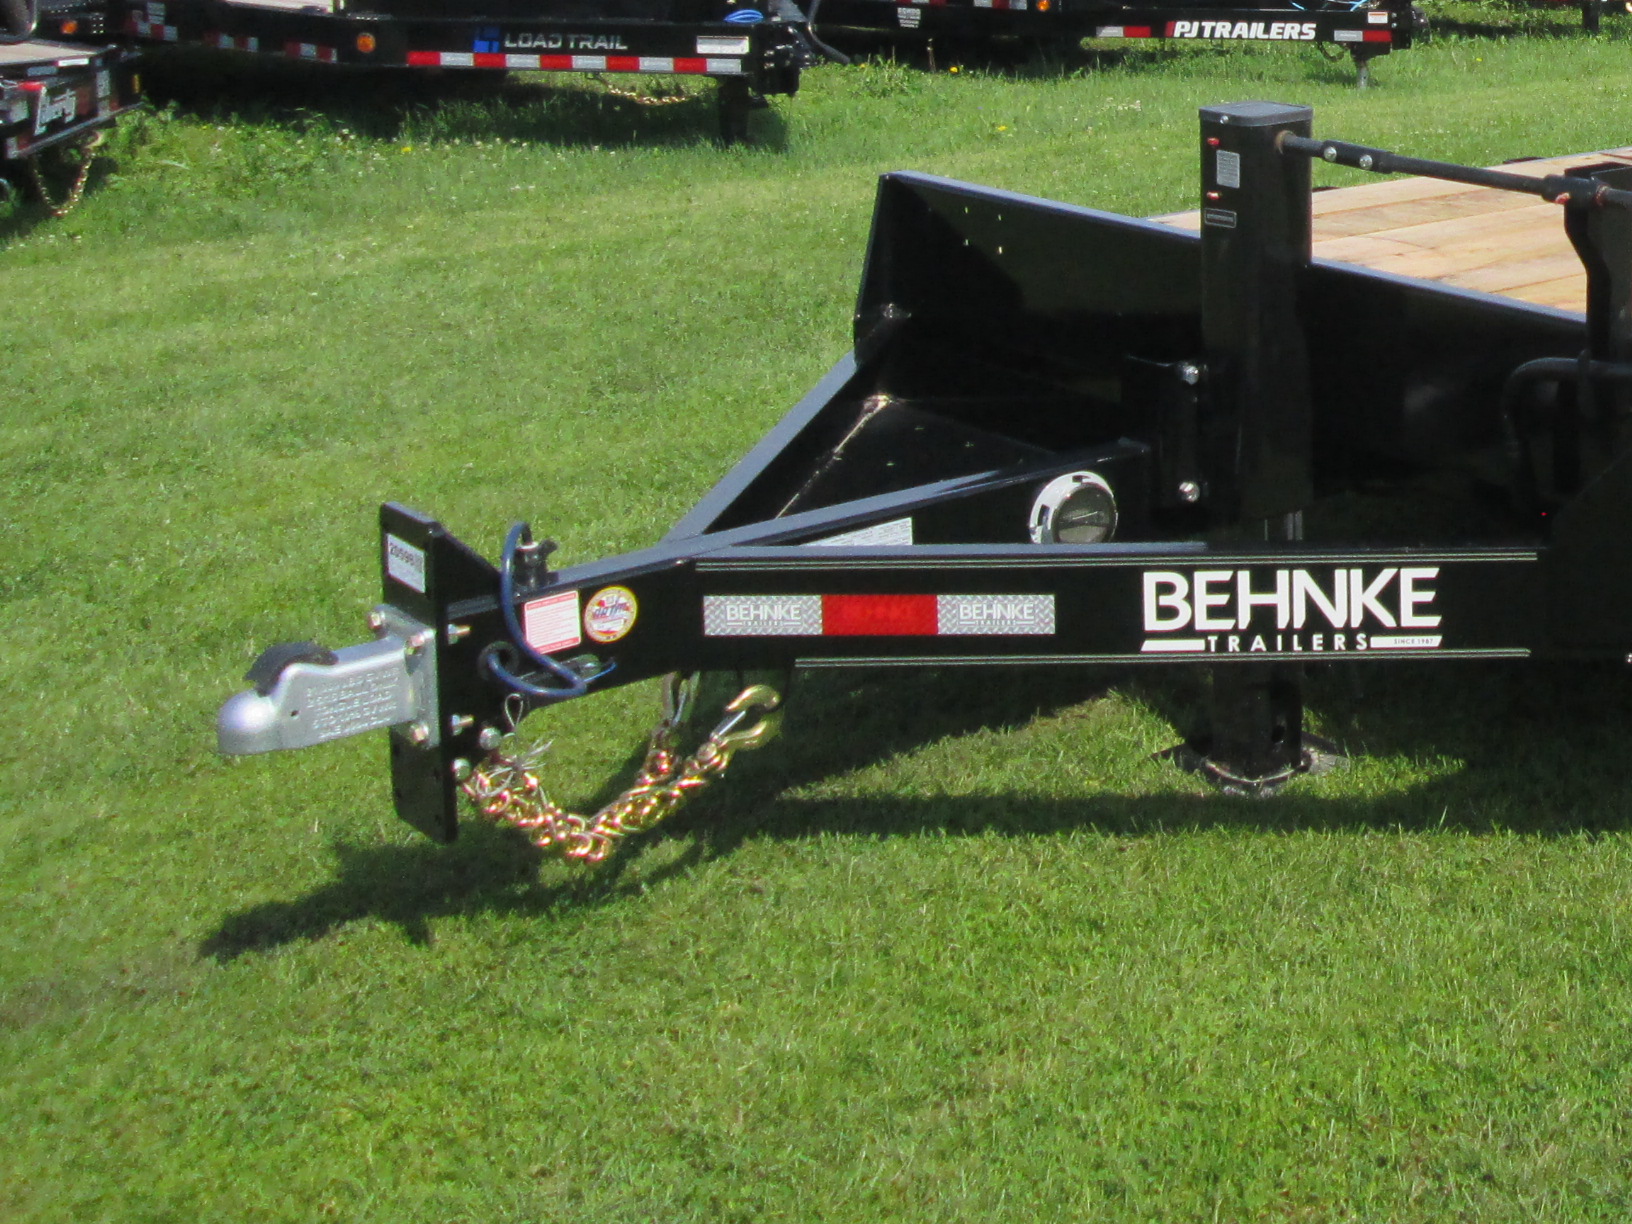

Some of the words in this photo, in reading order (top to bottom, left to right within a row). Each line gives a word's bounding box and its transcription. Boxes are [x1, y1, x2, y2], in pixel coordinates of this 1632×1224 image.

[1173, 21, 1199, 38] PJ
[1200, 22, 1317, 40] TRAILERS
[504, 33, 562, 49] LOAD
[567, 34, 628, 50] TRAIL
[1143, 568, 1442, 631] BEHNKE
[726, 605, 801, 621] BEHNKE
[959, 603, 1035, 620] BEHNKE
[1208, 633, 1368, 653] TRAILERS
[1417, 637, 1434, 645] 1987
